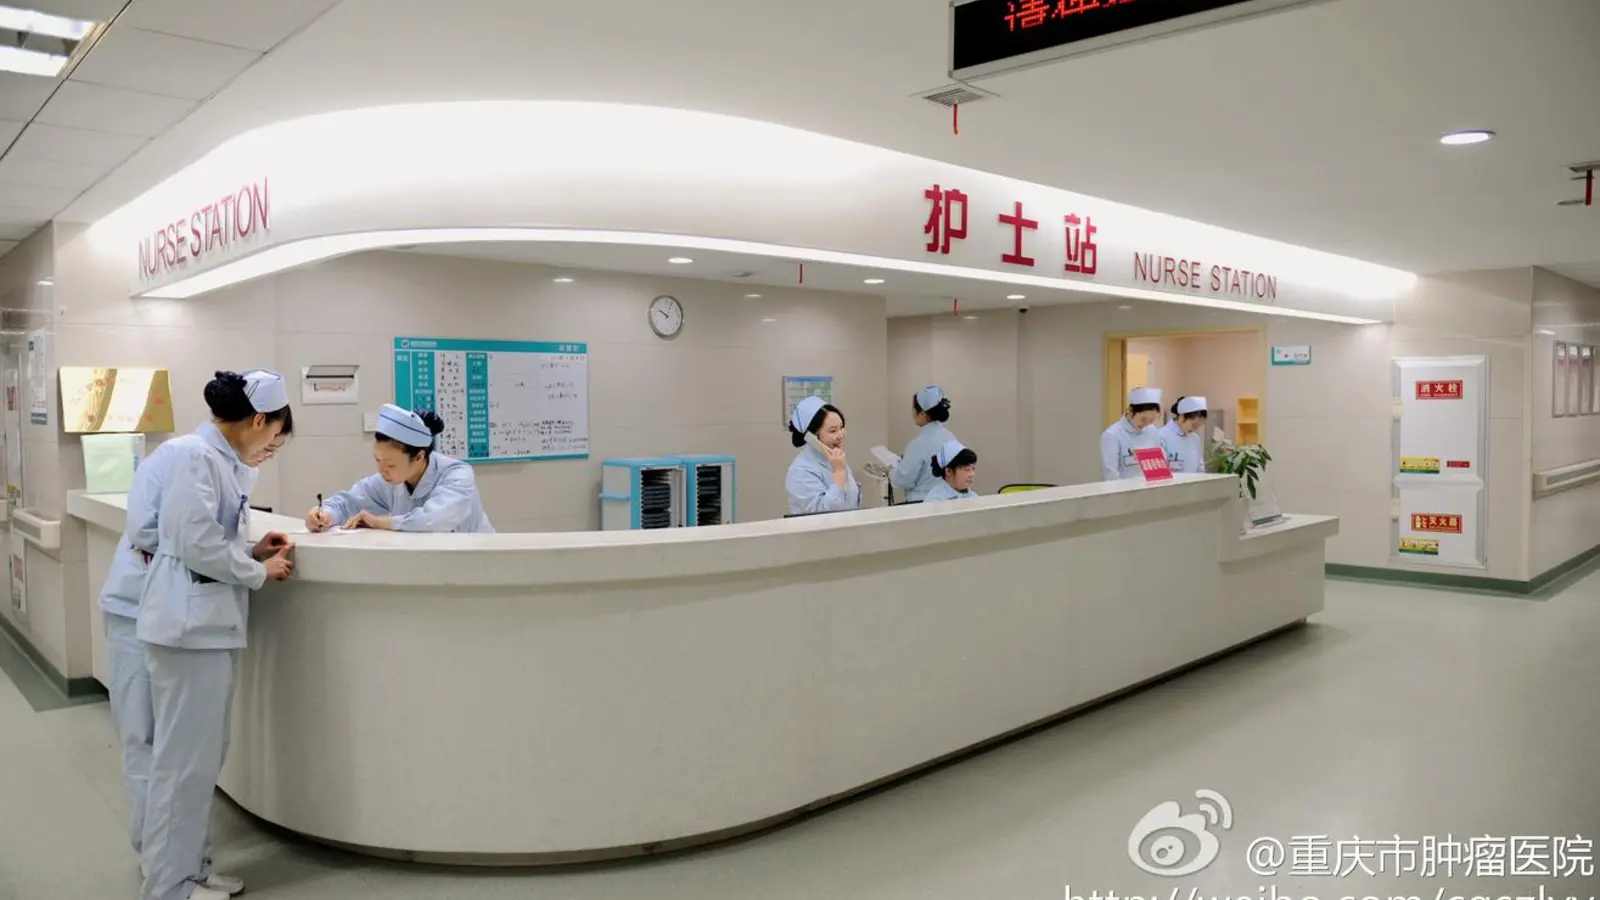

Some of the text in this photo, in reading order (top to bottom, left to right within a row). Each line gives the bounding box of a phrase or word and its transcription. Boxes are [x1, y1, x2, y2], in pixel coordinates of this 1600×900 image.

[138, 177, 269, 281] NURSE STATION
[924, 184, 1098, 275] 护士站
[1134, 252, 1277, 299] NURSE STATION
